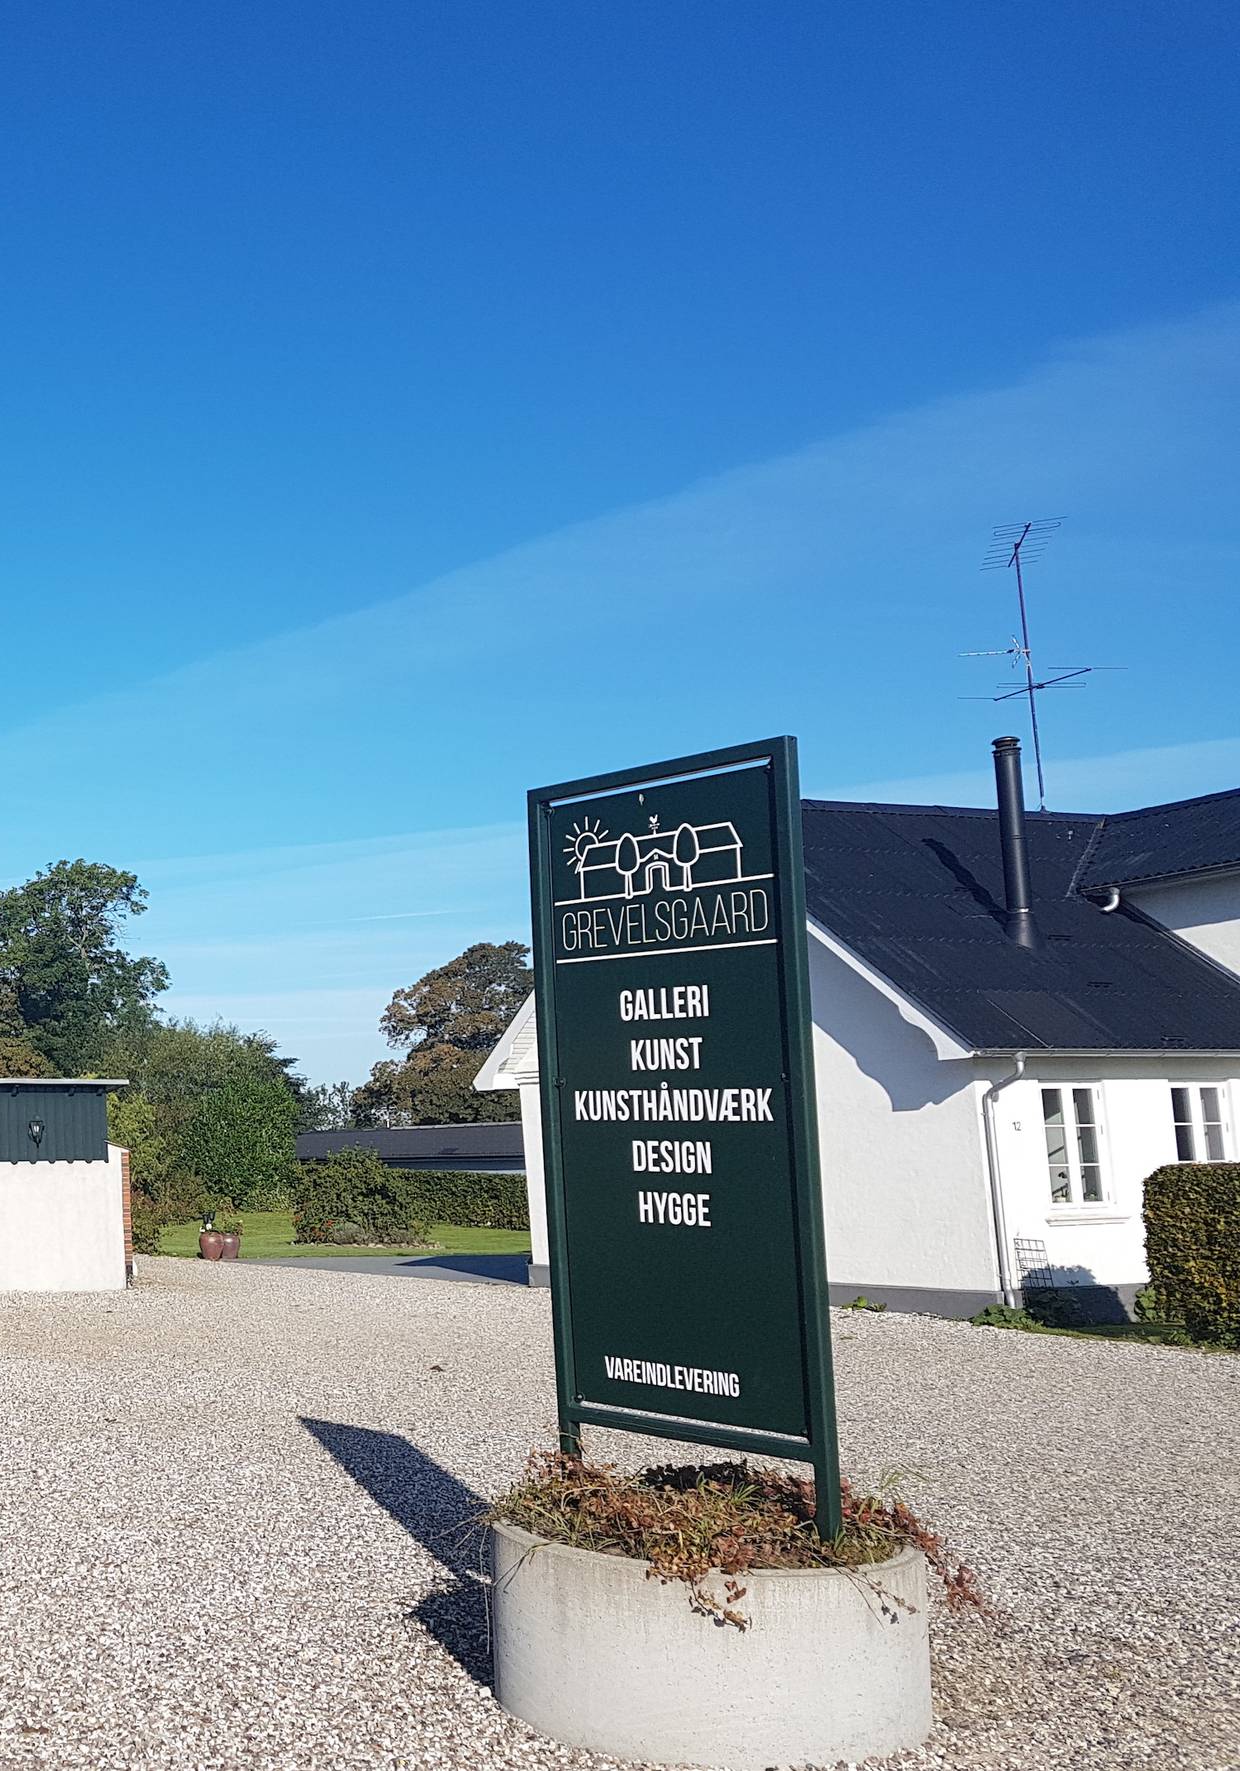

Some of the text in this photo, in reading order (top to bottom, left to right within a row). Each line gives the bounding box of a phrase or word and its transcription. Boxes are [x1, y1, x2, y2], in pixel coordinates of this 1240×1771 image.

[562, 889, 769, 951] GREVELSGAARD
[619, 984, 710, 1022] GALLERI
[630, 1036, 703, 1071] KUNST
[574, 1081, 774, 1122] KUNSTHÅNDVÆRK
[631, 1140, 713, 1174] DESIGN
[638, 1190, 712, 1227] HYGGE
[604, 1355, 740, 1398] VAREINDLEVERING
